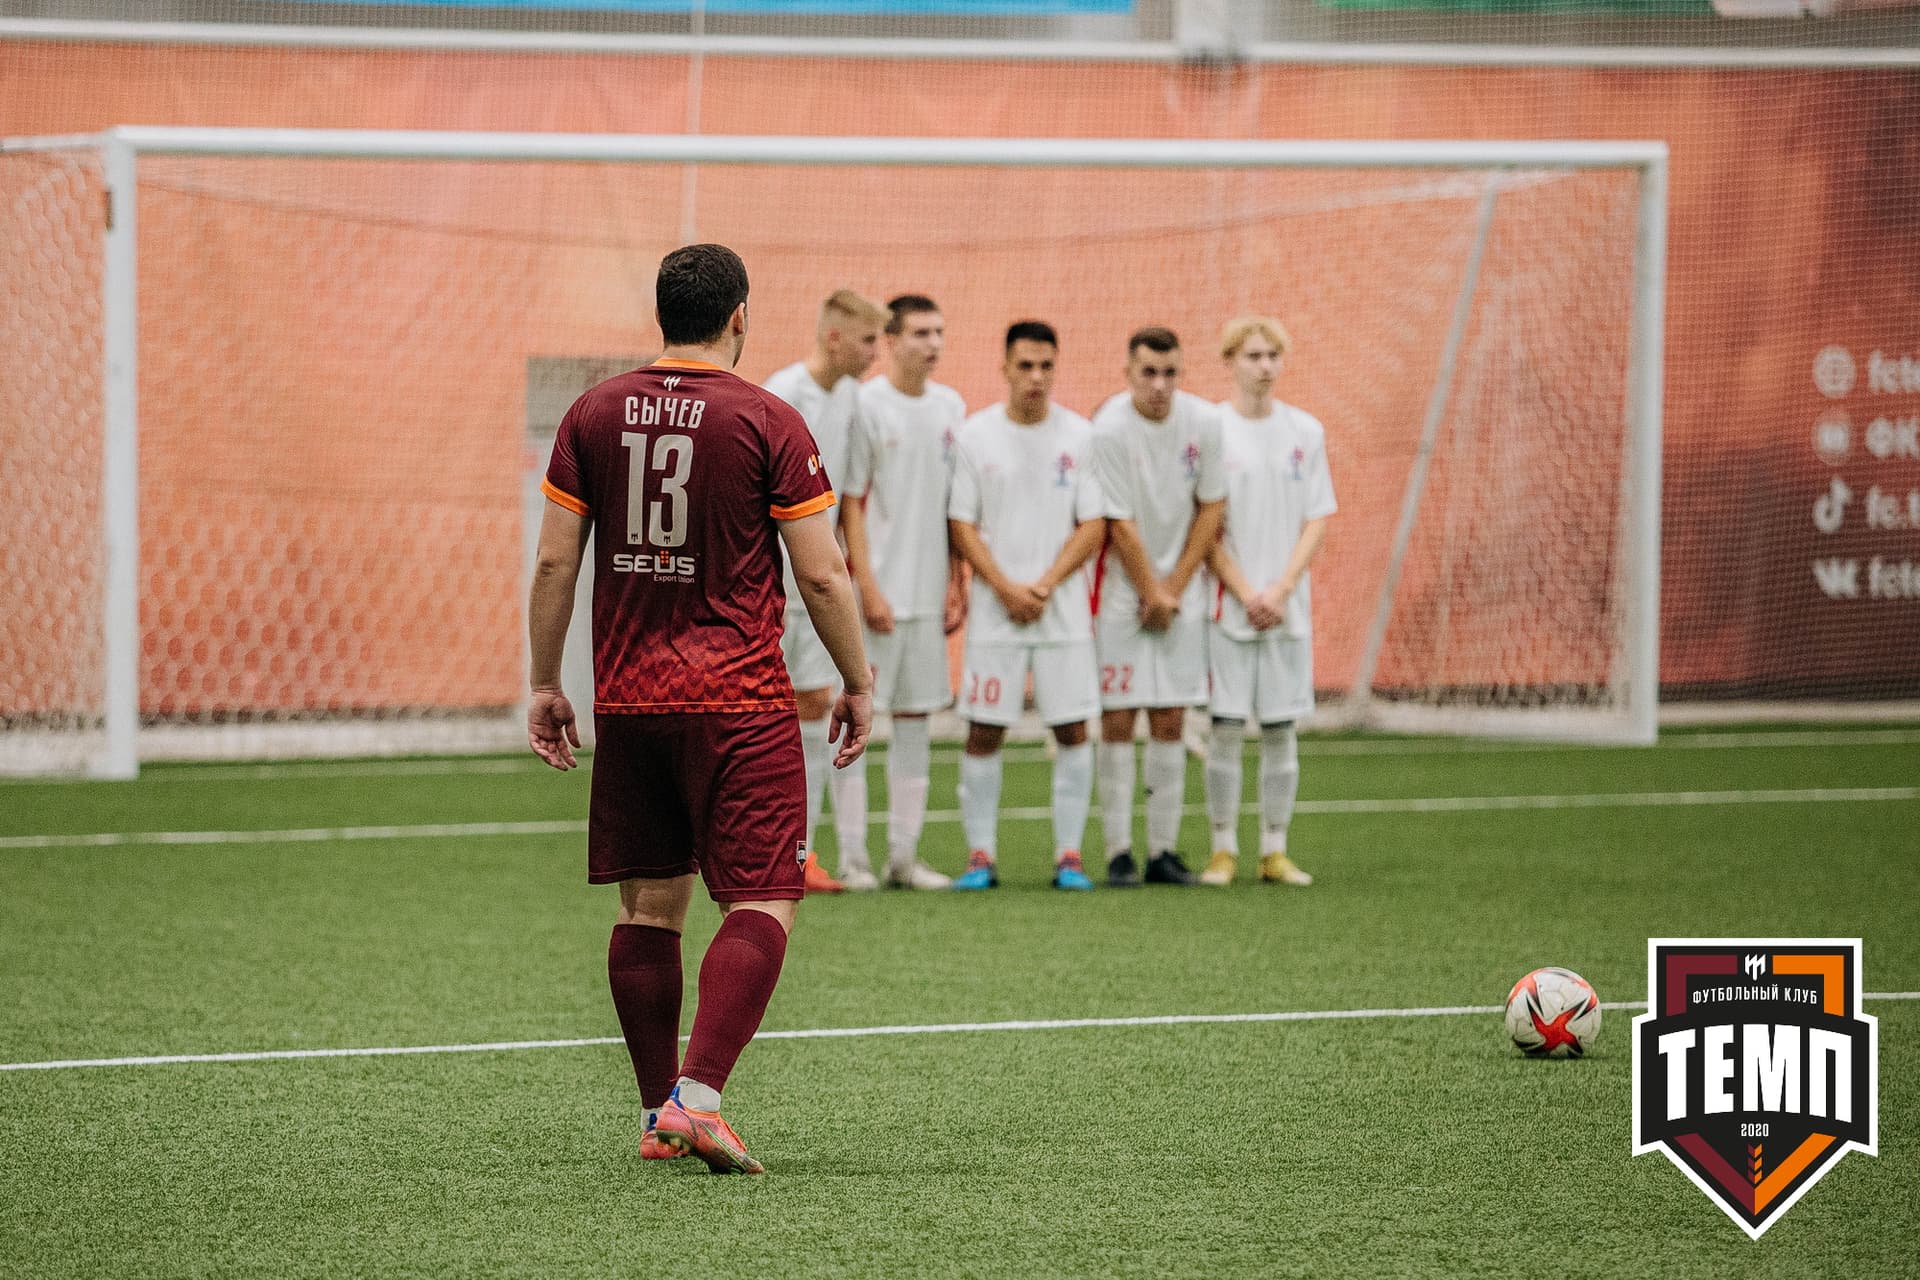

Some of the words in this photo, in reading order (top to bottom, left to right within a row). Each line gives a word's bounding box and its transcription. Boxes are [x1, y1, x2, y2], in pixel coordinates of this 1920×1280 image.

[624, 395, 706, 429] СЫЧЕВ
[621, 431, 694, 548] 13
[1102, 664, 1134, 695] 22
